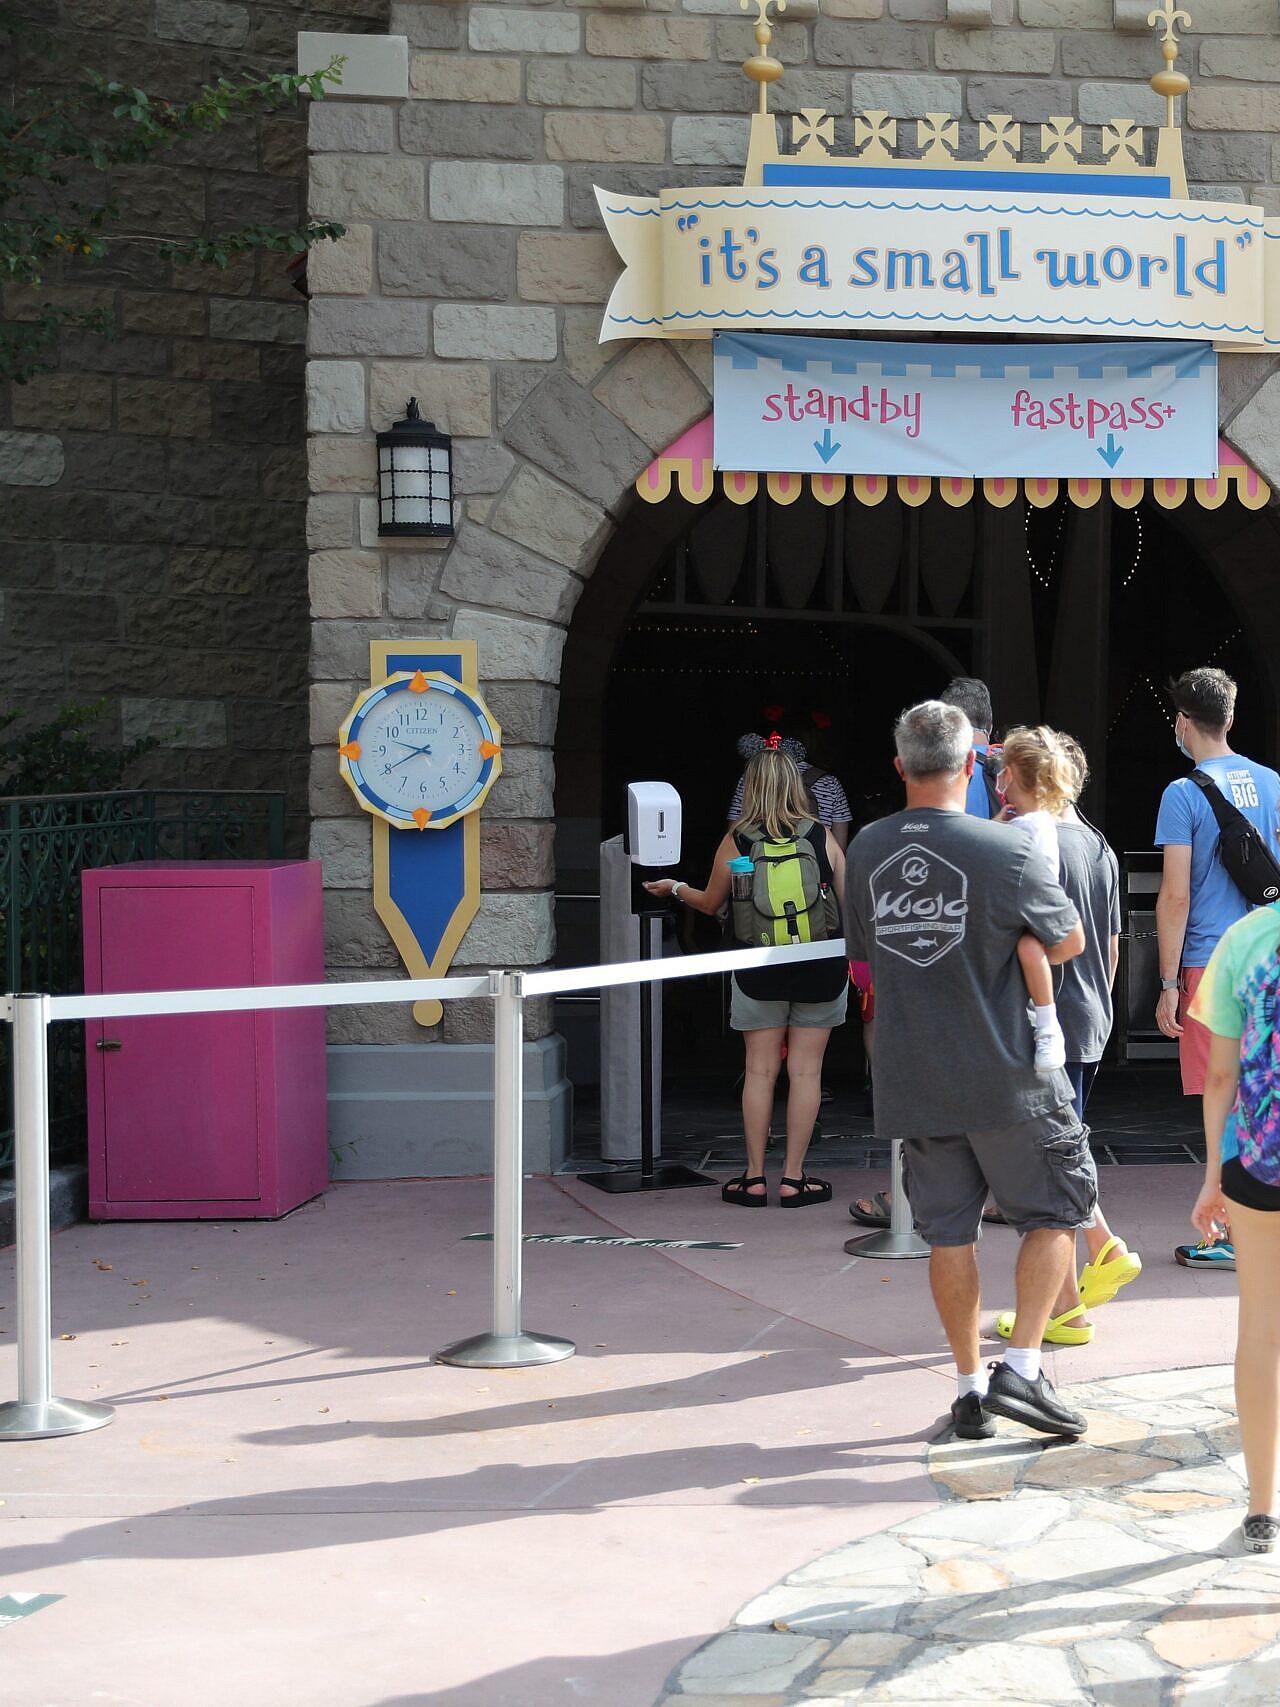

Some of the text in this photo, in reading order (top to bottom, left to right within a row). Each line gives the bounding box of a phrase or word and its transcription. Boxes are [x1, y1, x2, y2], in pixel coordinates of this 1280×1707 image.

[798, 246, 829, 288] a
[762, 384, 922, 438] stand-by
[1010, 390, 1177, 439] fastpass+
[399, 714, 410, 726] 11
[415, 708, 428, 721] 12
[438, 713, 444, 726] 1
[386, 726, 399, 739] 10
[452, 727, 459, 739] 2
[378, 744, 387, 757] 9
[459, 744, 465, 755] 3
[384, 763, 393, 775] 8
[452, 762, 460, 774] 4
[400, 776, 408, 789] 7
[419, 781, 428, 793] 6
[439, 776, 446, 789] 5
[1231, 783, 1259, 808] BIG
